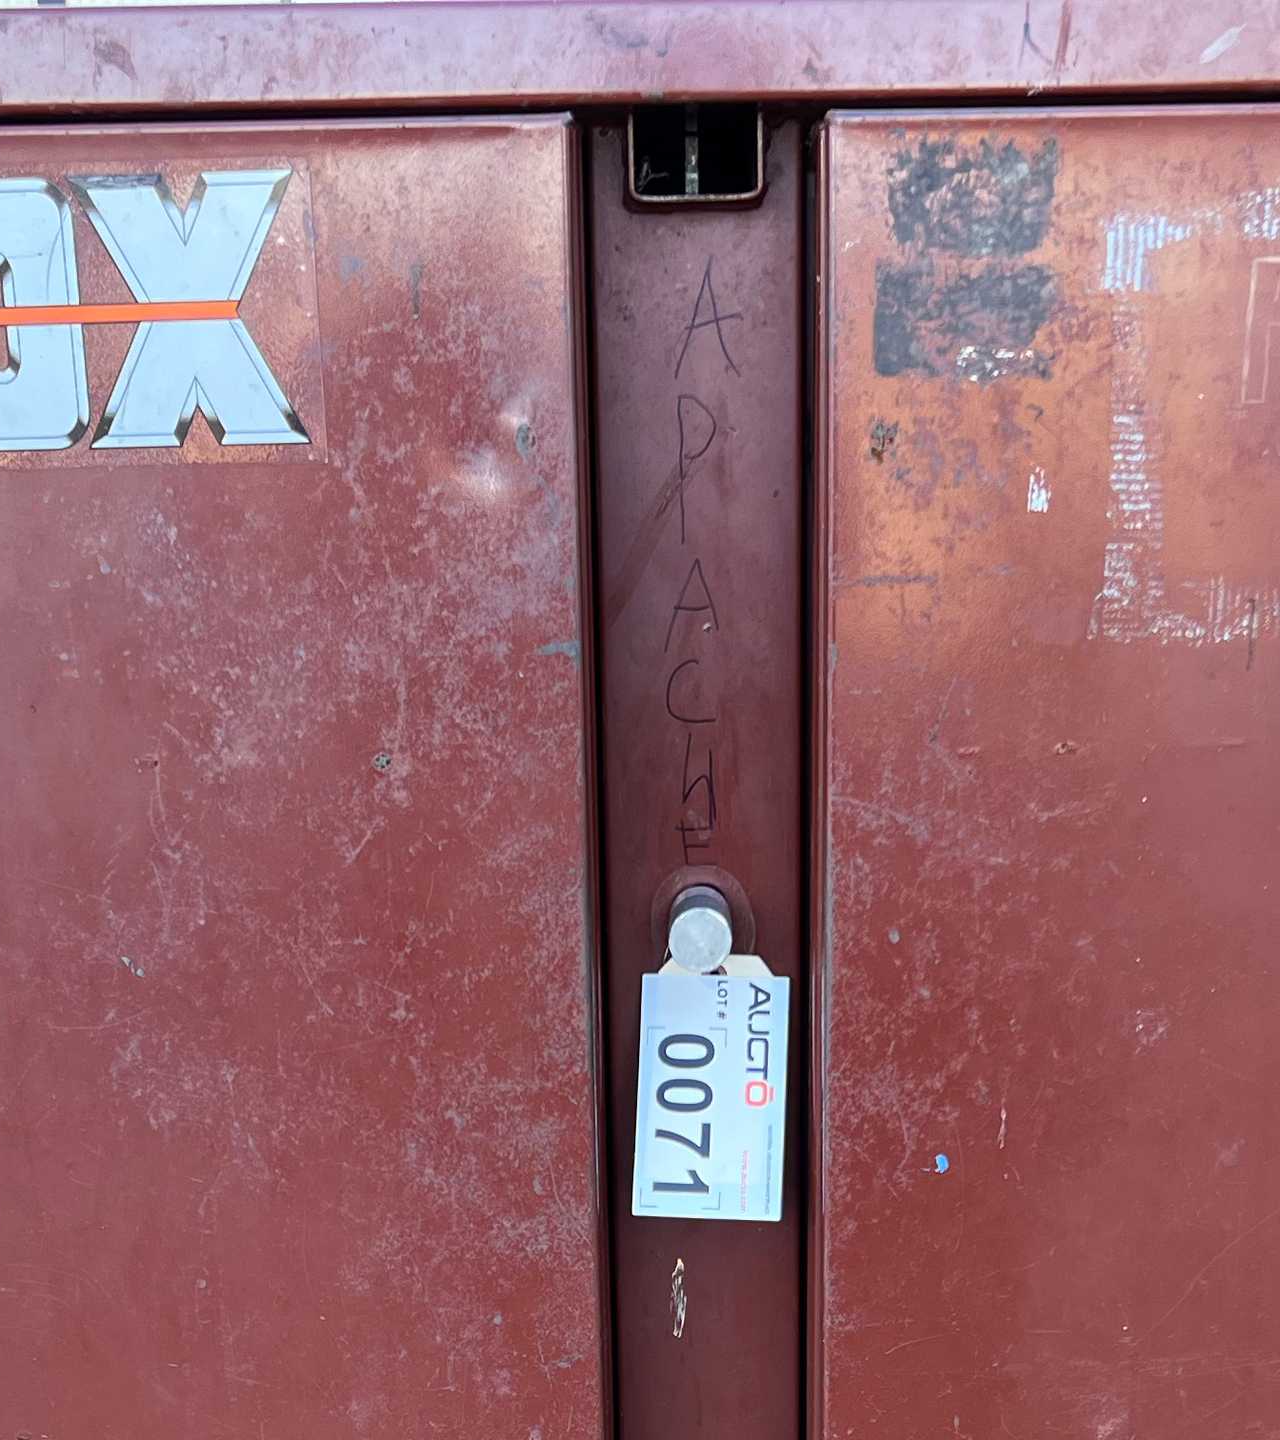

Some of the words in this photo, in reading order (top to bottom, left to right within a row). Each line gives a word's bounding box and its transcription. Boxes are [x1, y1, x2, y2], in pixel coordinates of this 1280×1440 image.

[717, 980, 728, 1006] LOT
[744, 982, 774, 1107] AUCTO
[652, 1033, 715, 1194] 0071
